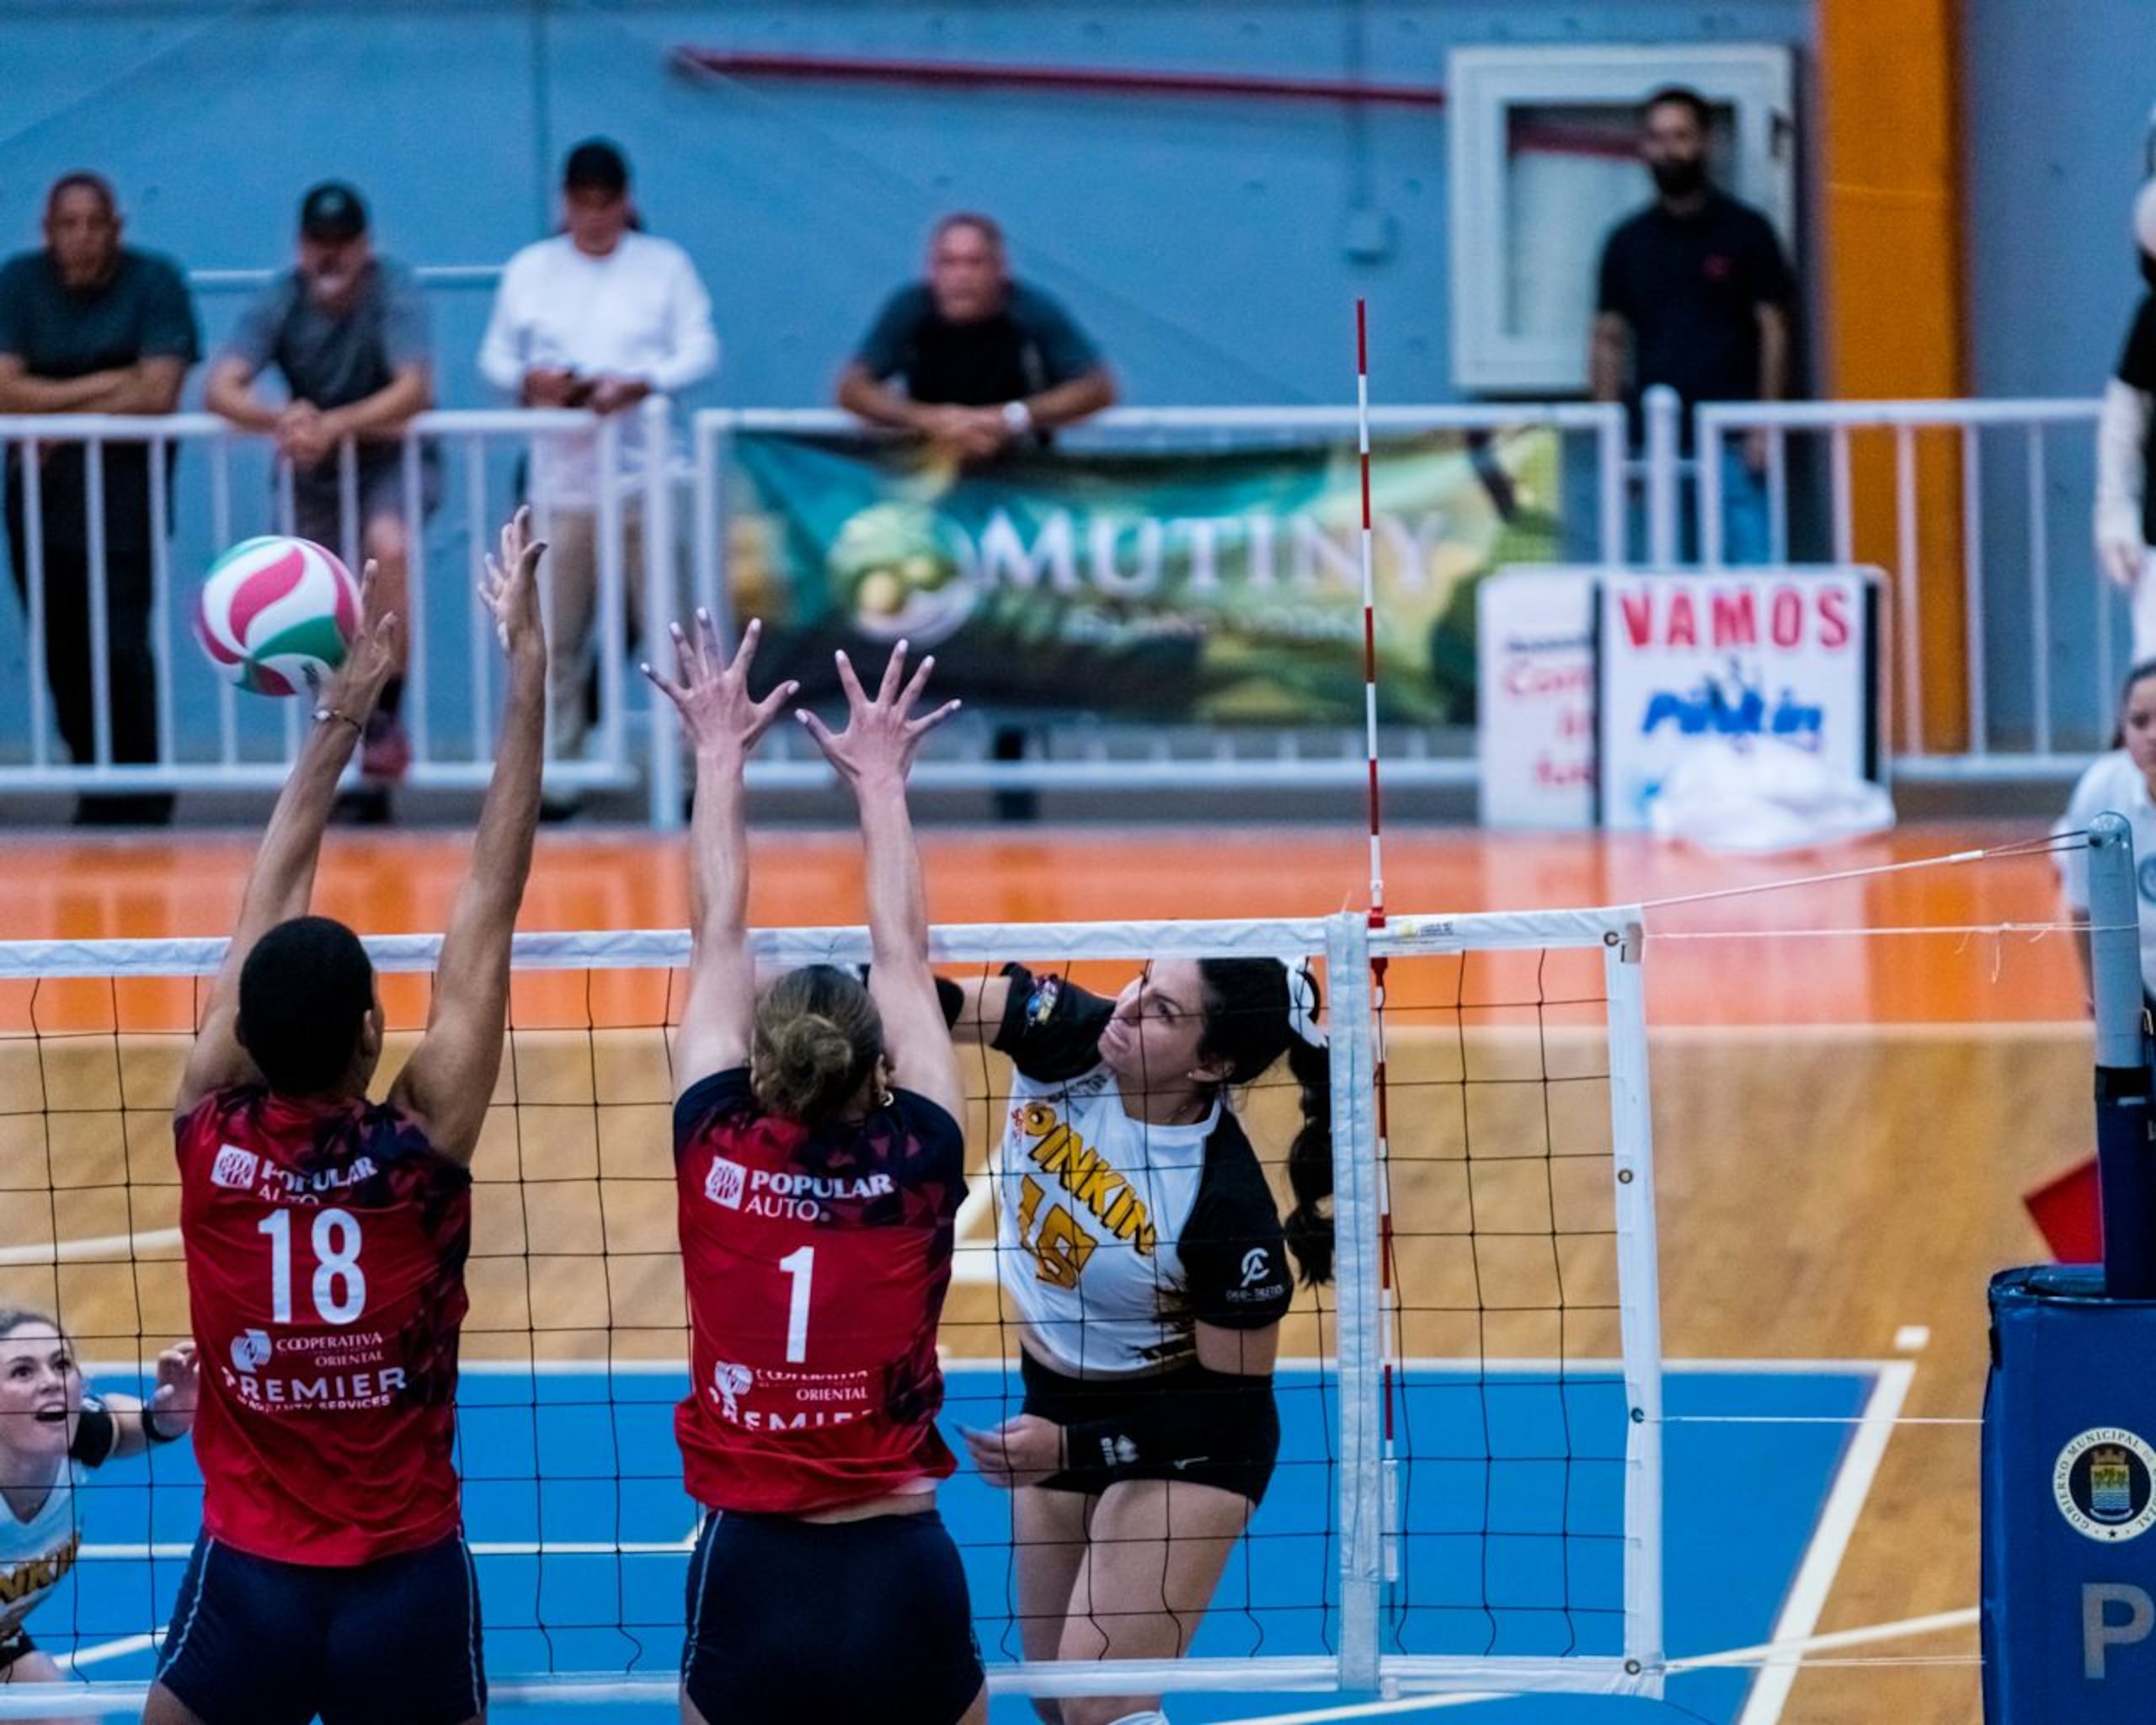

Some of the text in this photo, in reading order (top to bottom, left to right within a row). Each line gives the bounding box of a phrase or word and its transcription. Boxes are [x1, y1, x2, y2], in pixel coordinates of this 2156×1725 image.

[978, 510, 1443, 596] MUTINY
[1621, 588, 1848, 648] VAMOS
[750, 1170, 894, 1199] POPULAR
[745, 1195, 820, 1221] AUTO
[258, 1208, 366, 1324] 18
[779, 1246, 814, 1364] 1
[275, 1332, 383, 1351] COOPERATIVA
[315, 1352, 384, 1368] ORIENTAL
[796, 1386, 868, 1402] ORIENTAL
[2068, 1431, 2137, 1456] MUNICIPAL
[2057, 1461, 2089, 1530] GOBIERNO
